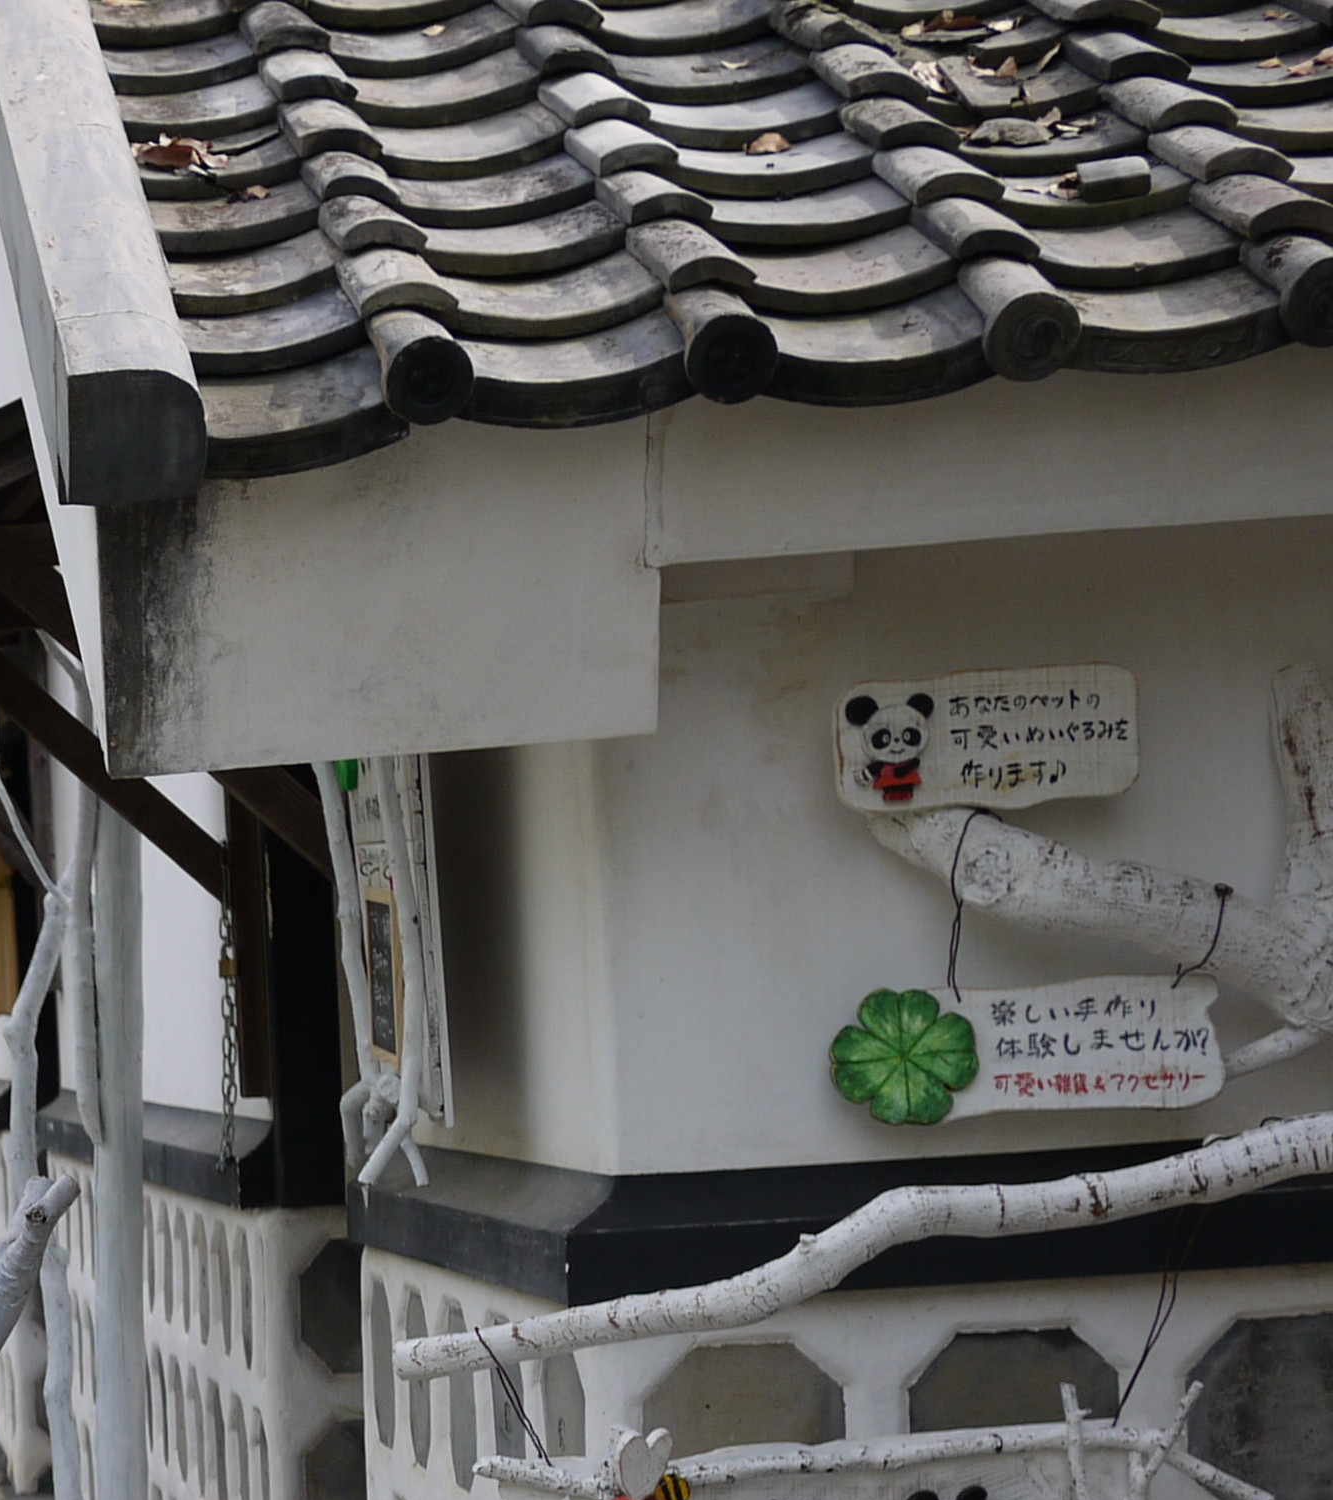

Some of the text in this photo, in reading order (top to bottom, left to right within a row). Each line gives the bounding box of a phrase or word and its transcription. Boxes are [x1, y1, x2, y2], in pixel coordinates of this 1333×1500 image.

[949, 689, 1101, 718] あなたのペットの
[950, 718, 1130, 751] 可愛いぬいぐるみを
[990, 994, 1157, 1027] 楽しい手作り
